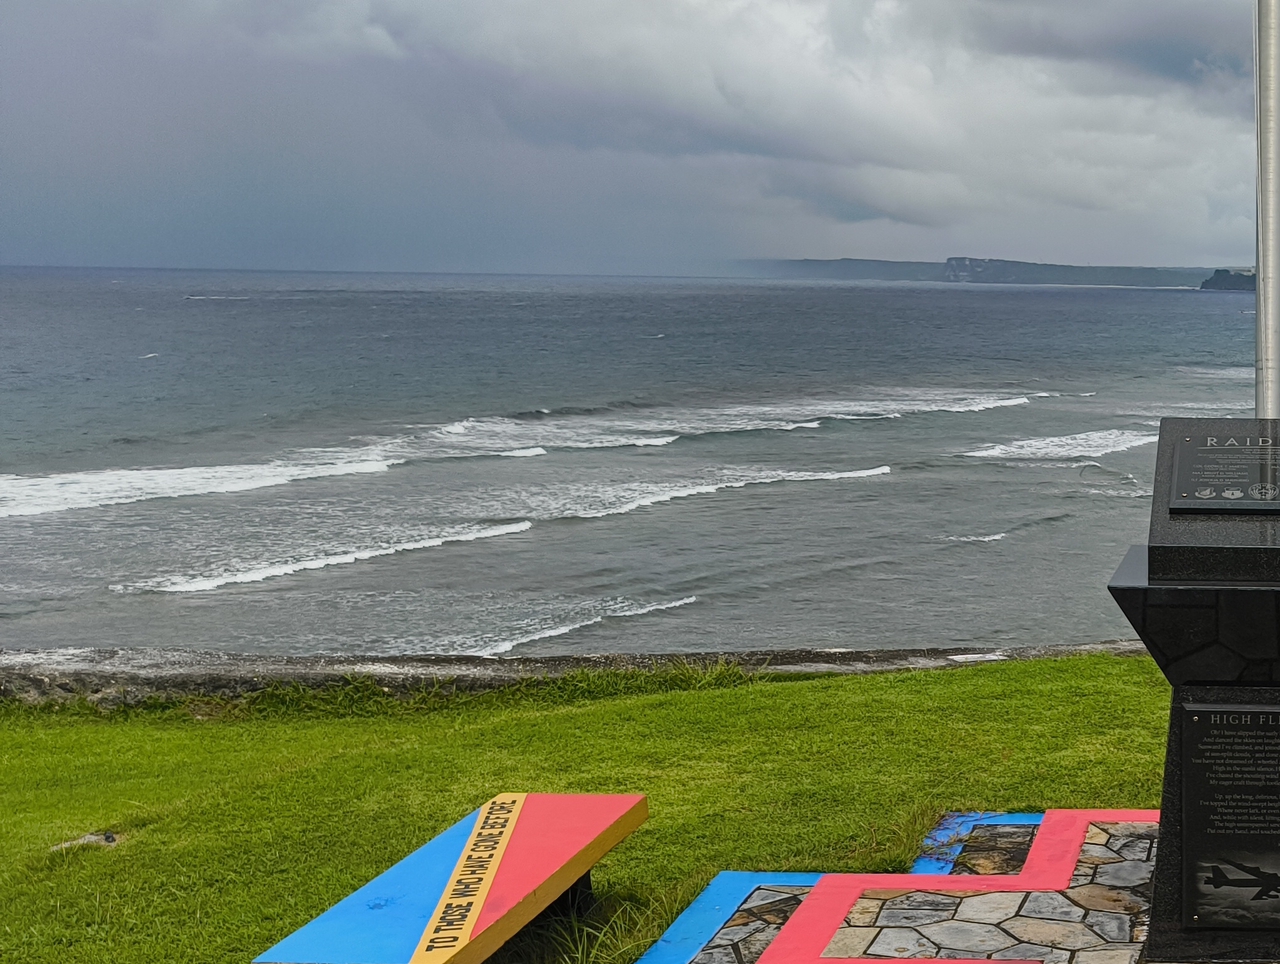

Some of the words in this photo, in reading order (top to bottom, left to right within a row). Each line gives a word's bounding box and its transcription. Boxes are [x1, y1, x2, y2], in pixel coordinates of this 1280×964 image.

[1210, 714, 1251, 725] HIGH
[480, 800, 517, 830] BEFORE
[471, 831, 504, 852] GONE
[459, 853, 494, 876] HAVE
[449, 877, 484, 899] WHO
[433, 902, 474, 934] THOSE
[425, 936, 459, 952] TO
